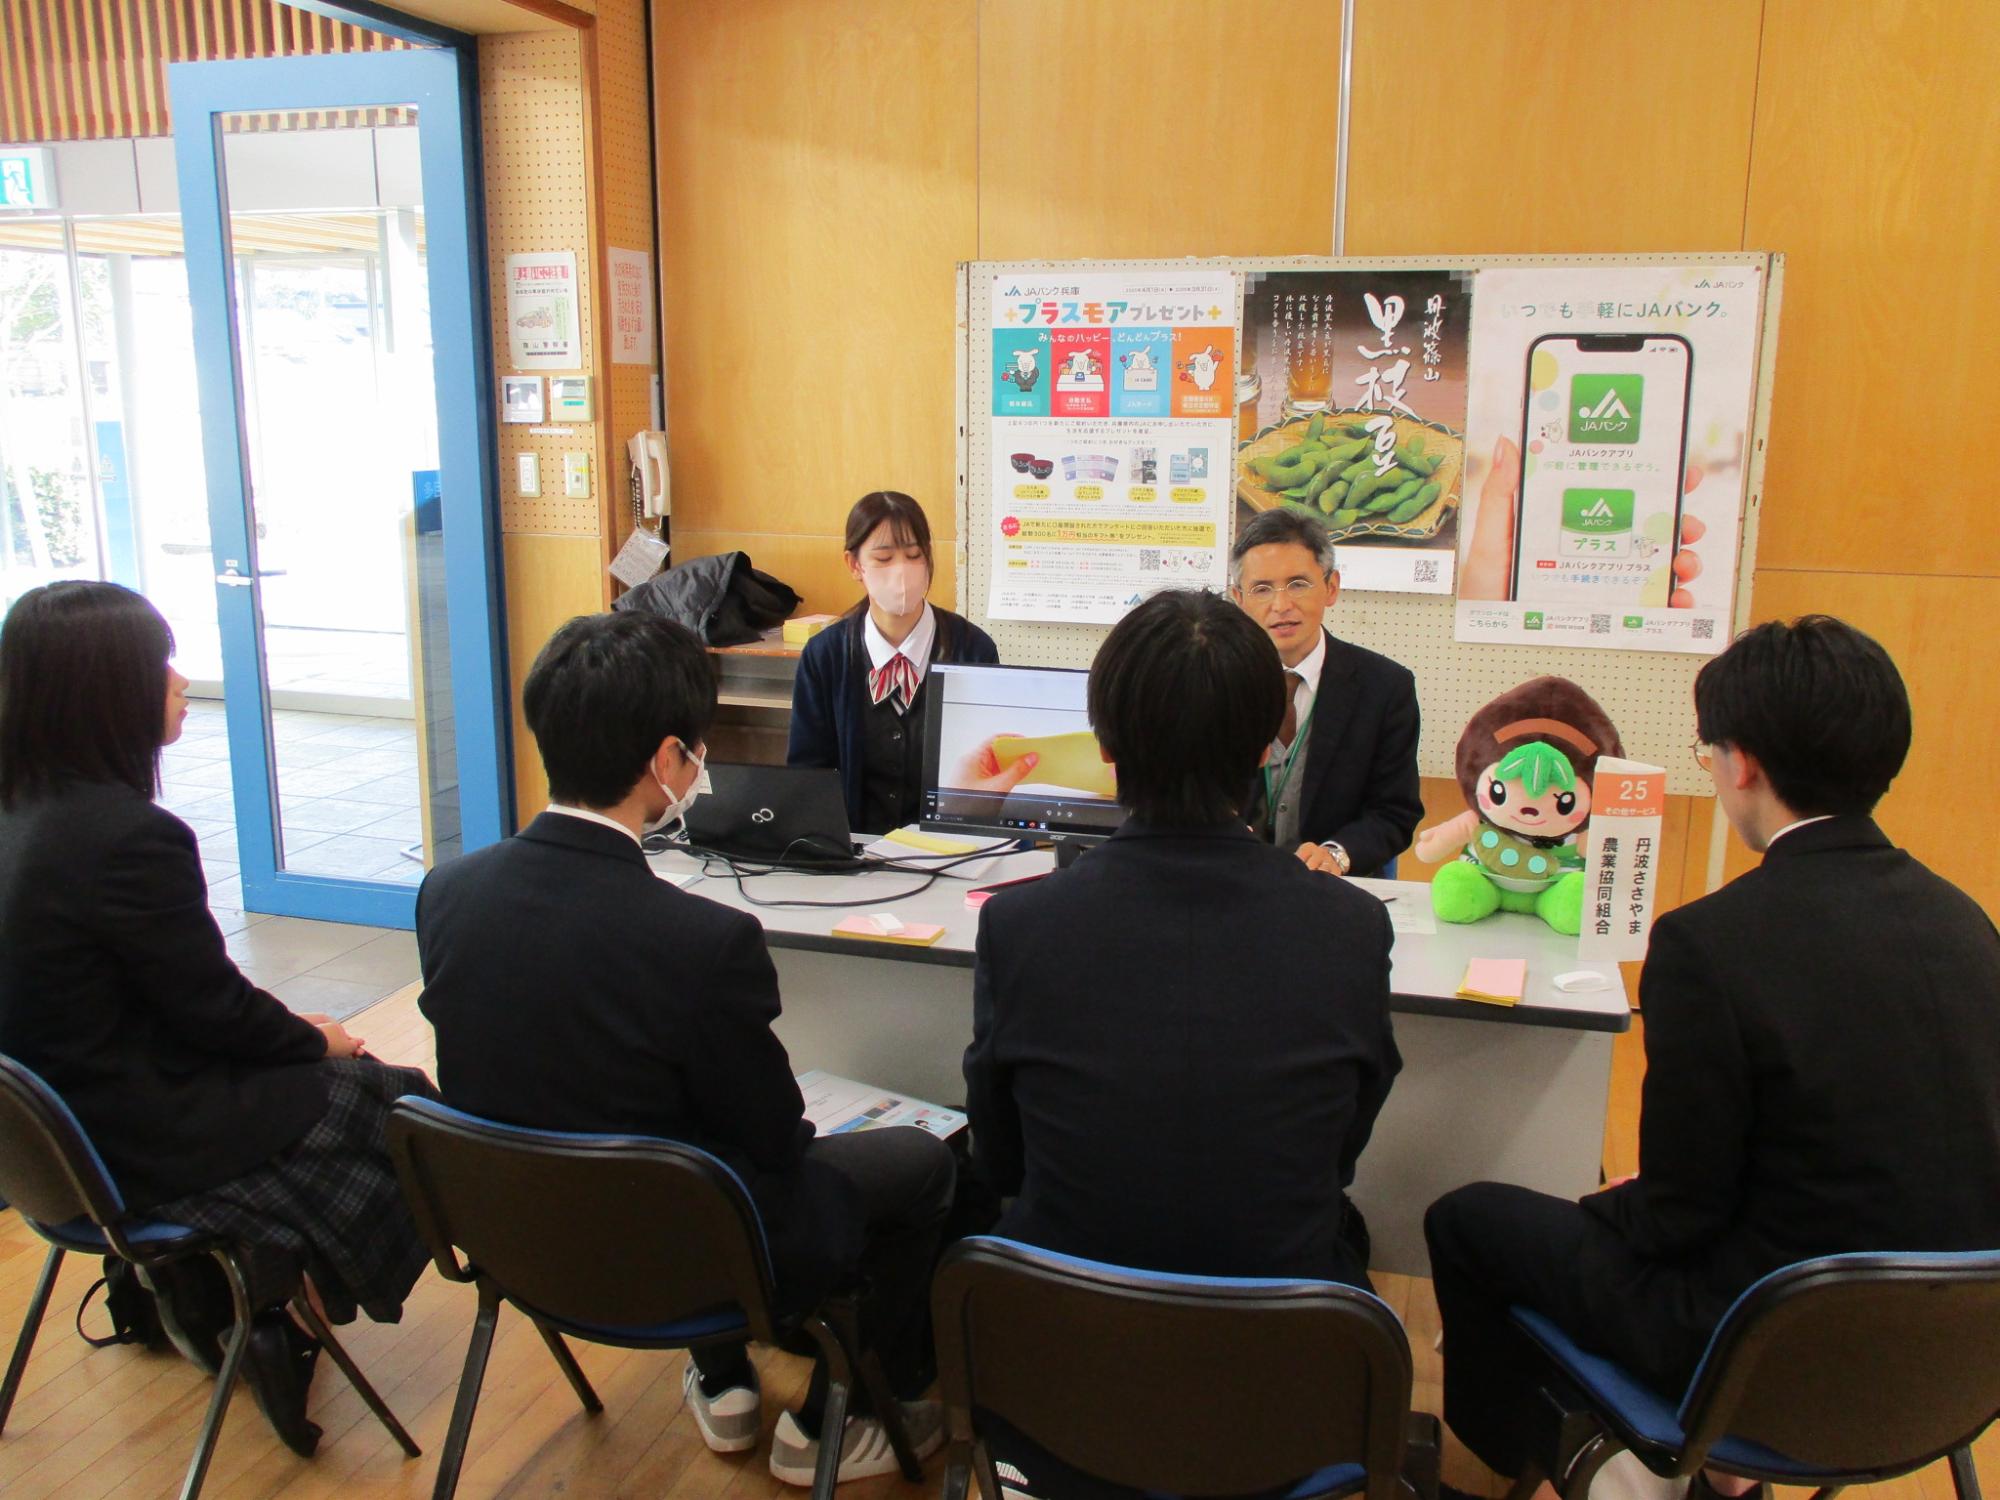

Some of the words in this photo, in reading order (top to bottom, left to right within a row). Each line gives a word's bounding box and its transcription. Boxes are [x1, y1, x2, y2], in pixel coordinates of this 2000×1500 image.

[1024, 287, 1080, 296] JAバンク兵庫
[1422, 294, 1446, 380] 丹波篠山
[1580, 421, 1628, 432] JAバンク
[1569, 449, 1633, 458] JAバンクアプリ
[1573, 537, 1617, 552] プラス
[1560, 561, 1623, 571] JAバンクアプリ
[1626, 563, 1651, 572] プラス
[1469, 619, 1509, 629] こちらから
[1619, 780, 1648, 800] 25
[1604, 807, 1657, 815] その他サービス
[1595, 837, 1618, 935] 農業協同組合
[1629, 837, 1651, 935] 丹波ささやま
